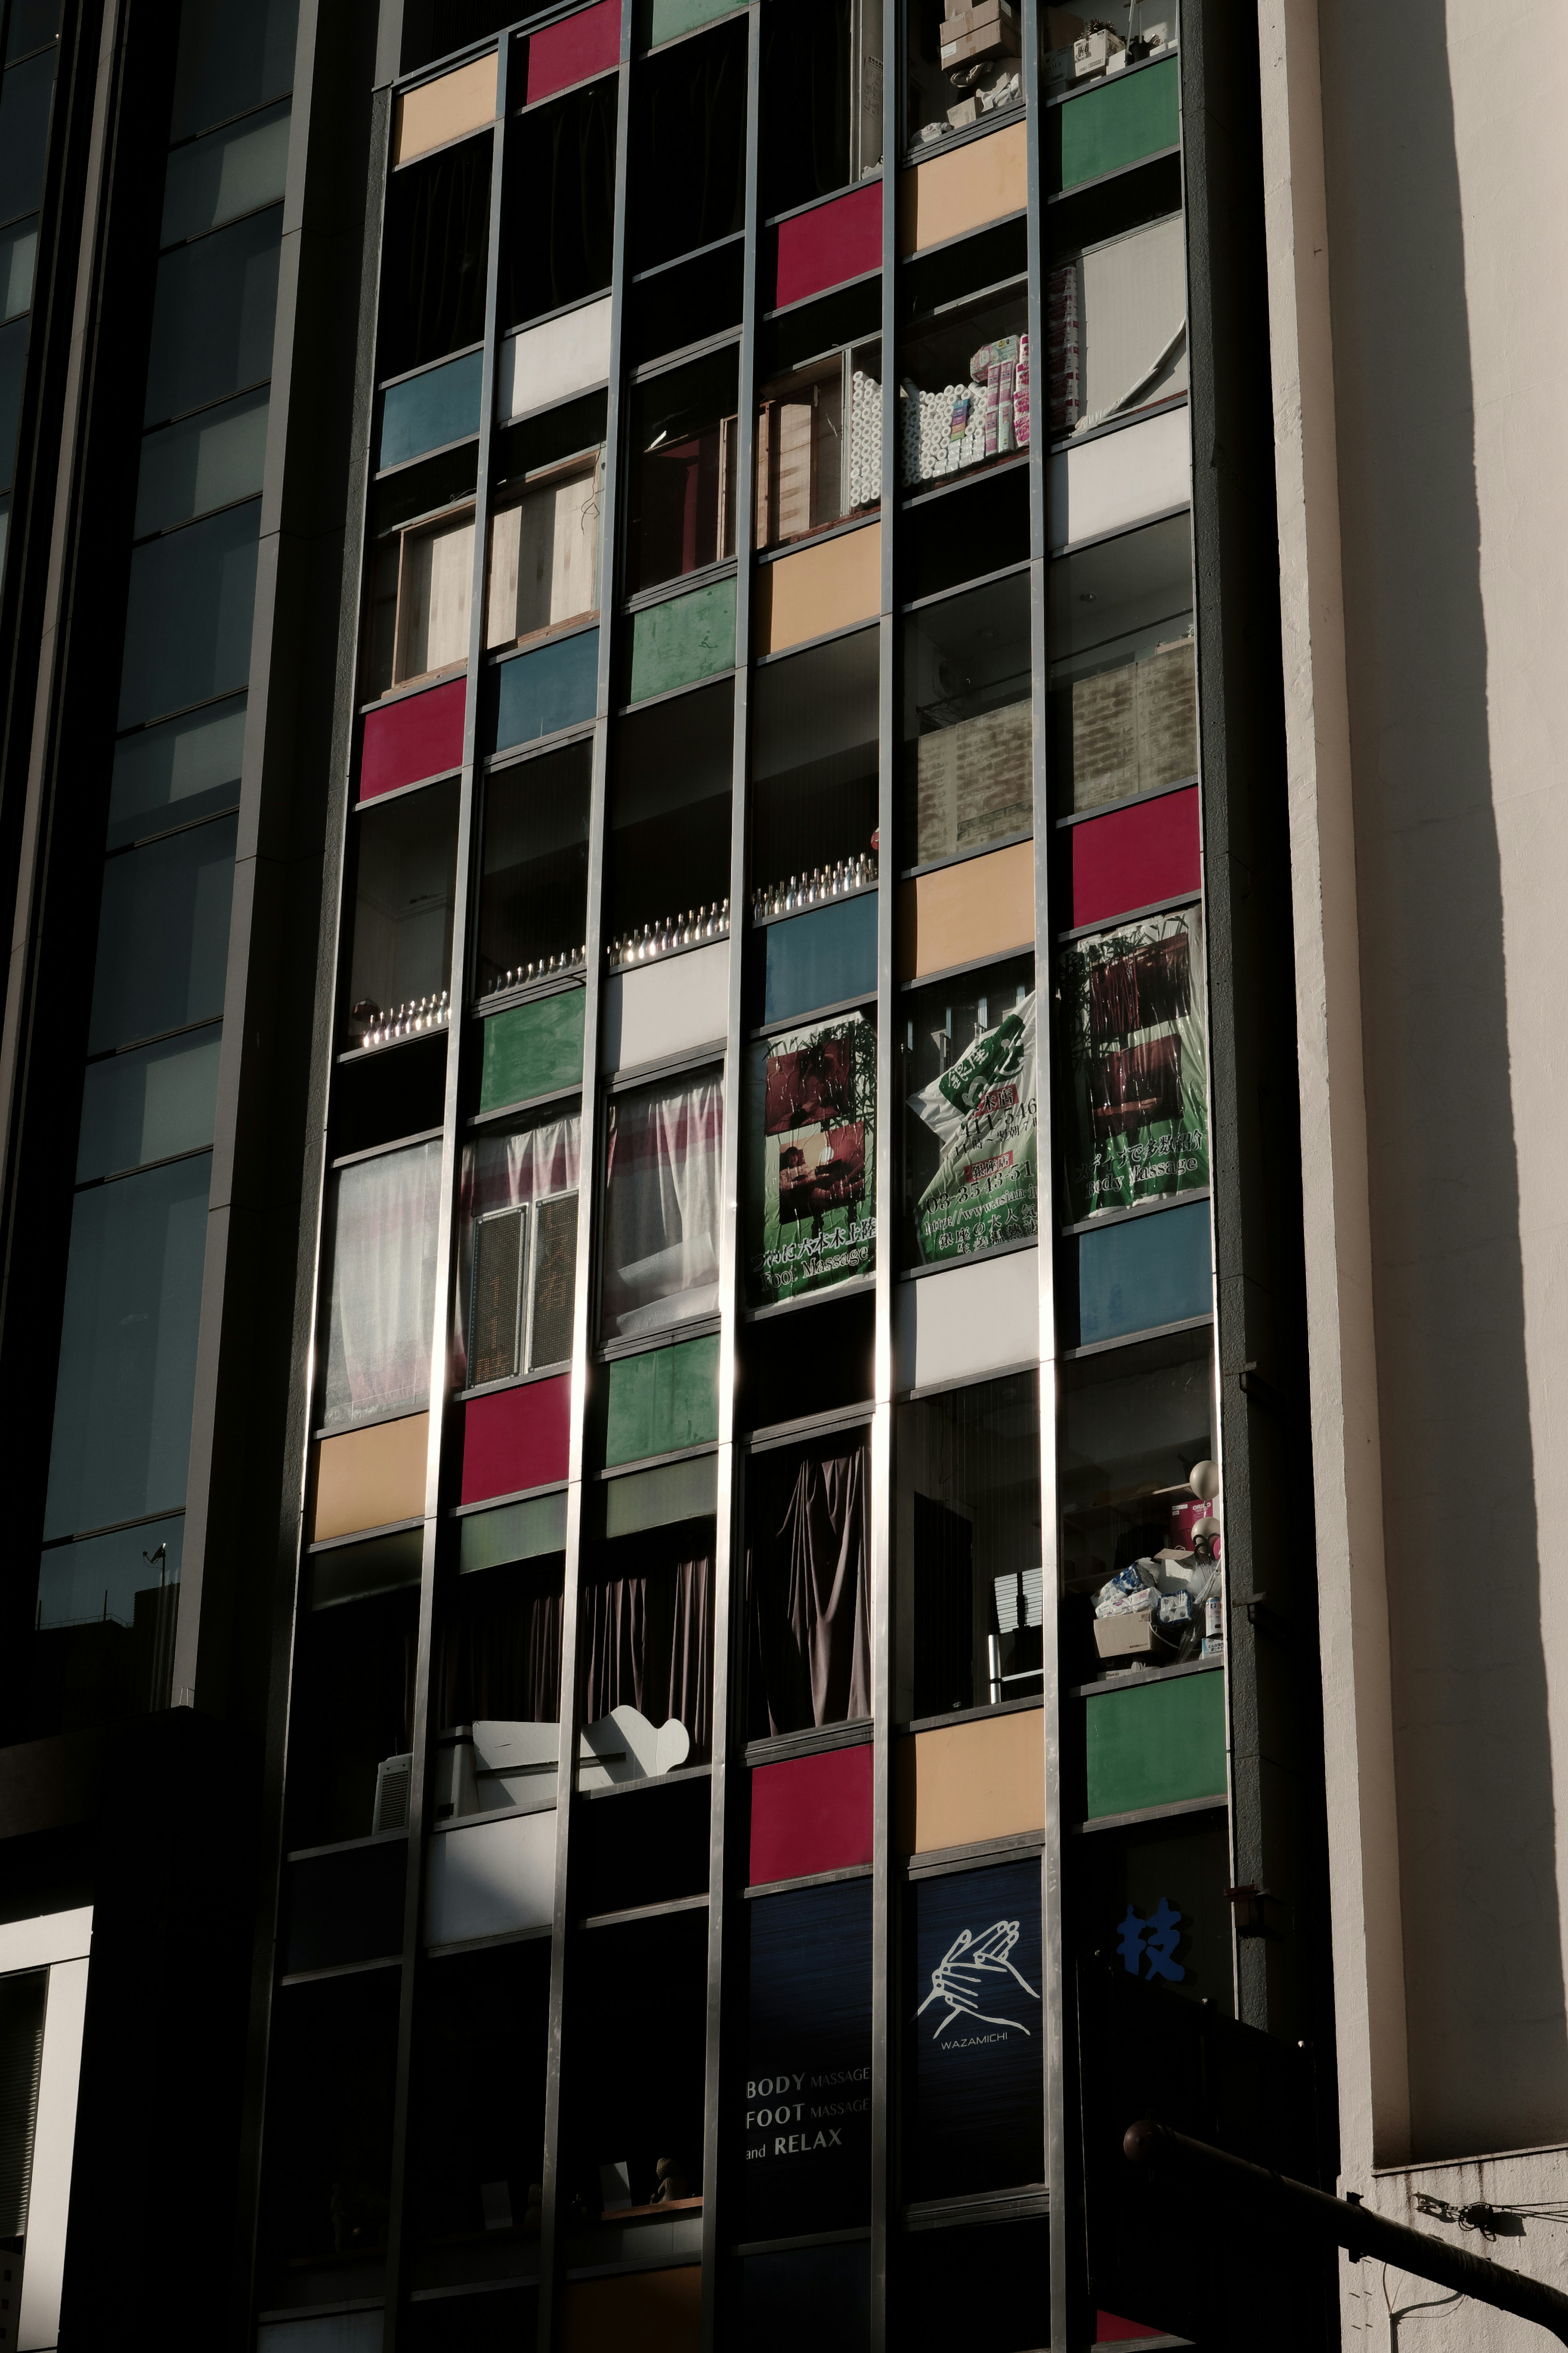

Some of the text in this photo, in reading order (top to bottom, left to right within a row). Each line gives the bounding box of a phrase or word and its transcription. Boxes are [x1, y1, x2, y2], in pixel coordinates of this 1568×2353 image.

[971, 1154, 1010, 1180] 銀座店
[1085, 1158, 1198, 1200] Body Massage
[760, 1246, 869, 1291] Foot Massage
[1116, 1897, 1186, 1982] 技
[941, 2032, 1008, 2050] WAZAMICHI
[746, 2067, 870, 2099] BODY MASSAGE
[746, 2098, 870, 2129] FOOT MASSAGE
[746, 2128, 842, 2160] and RELAX
